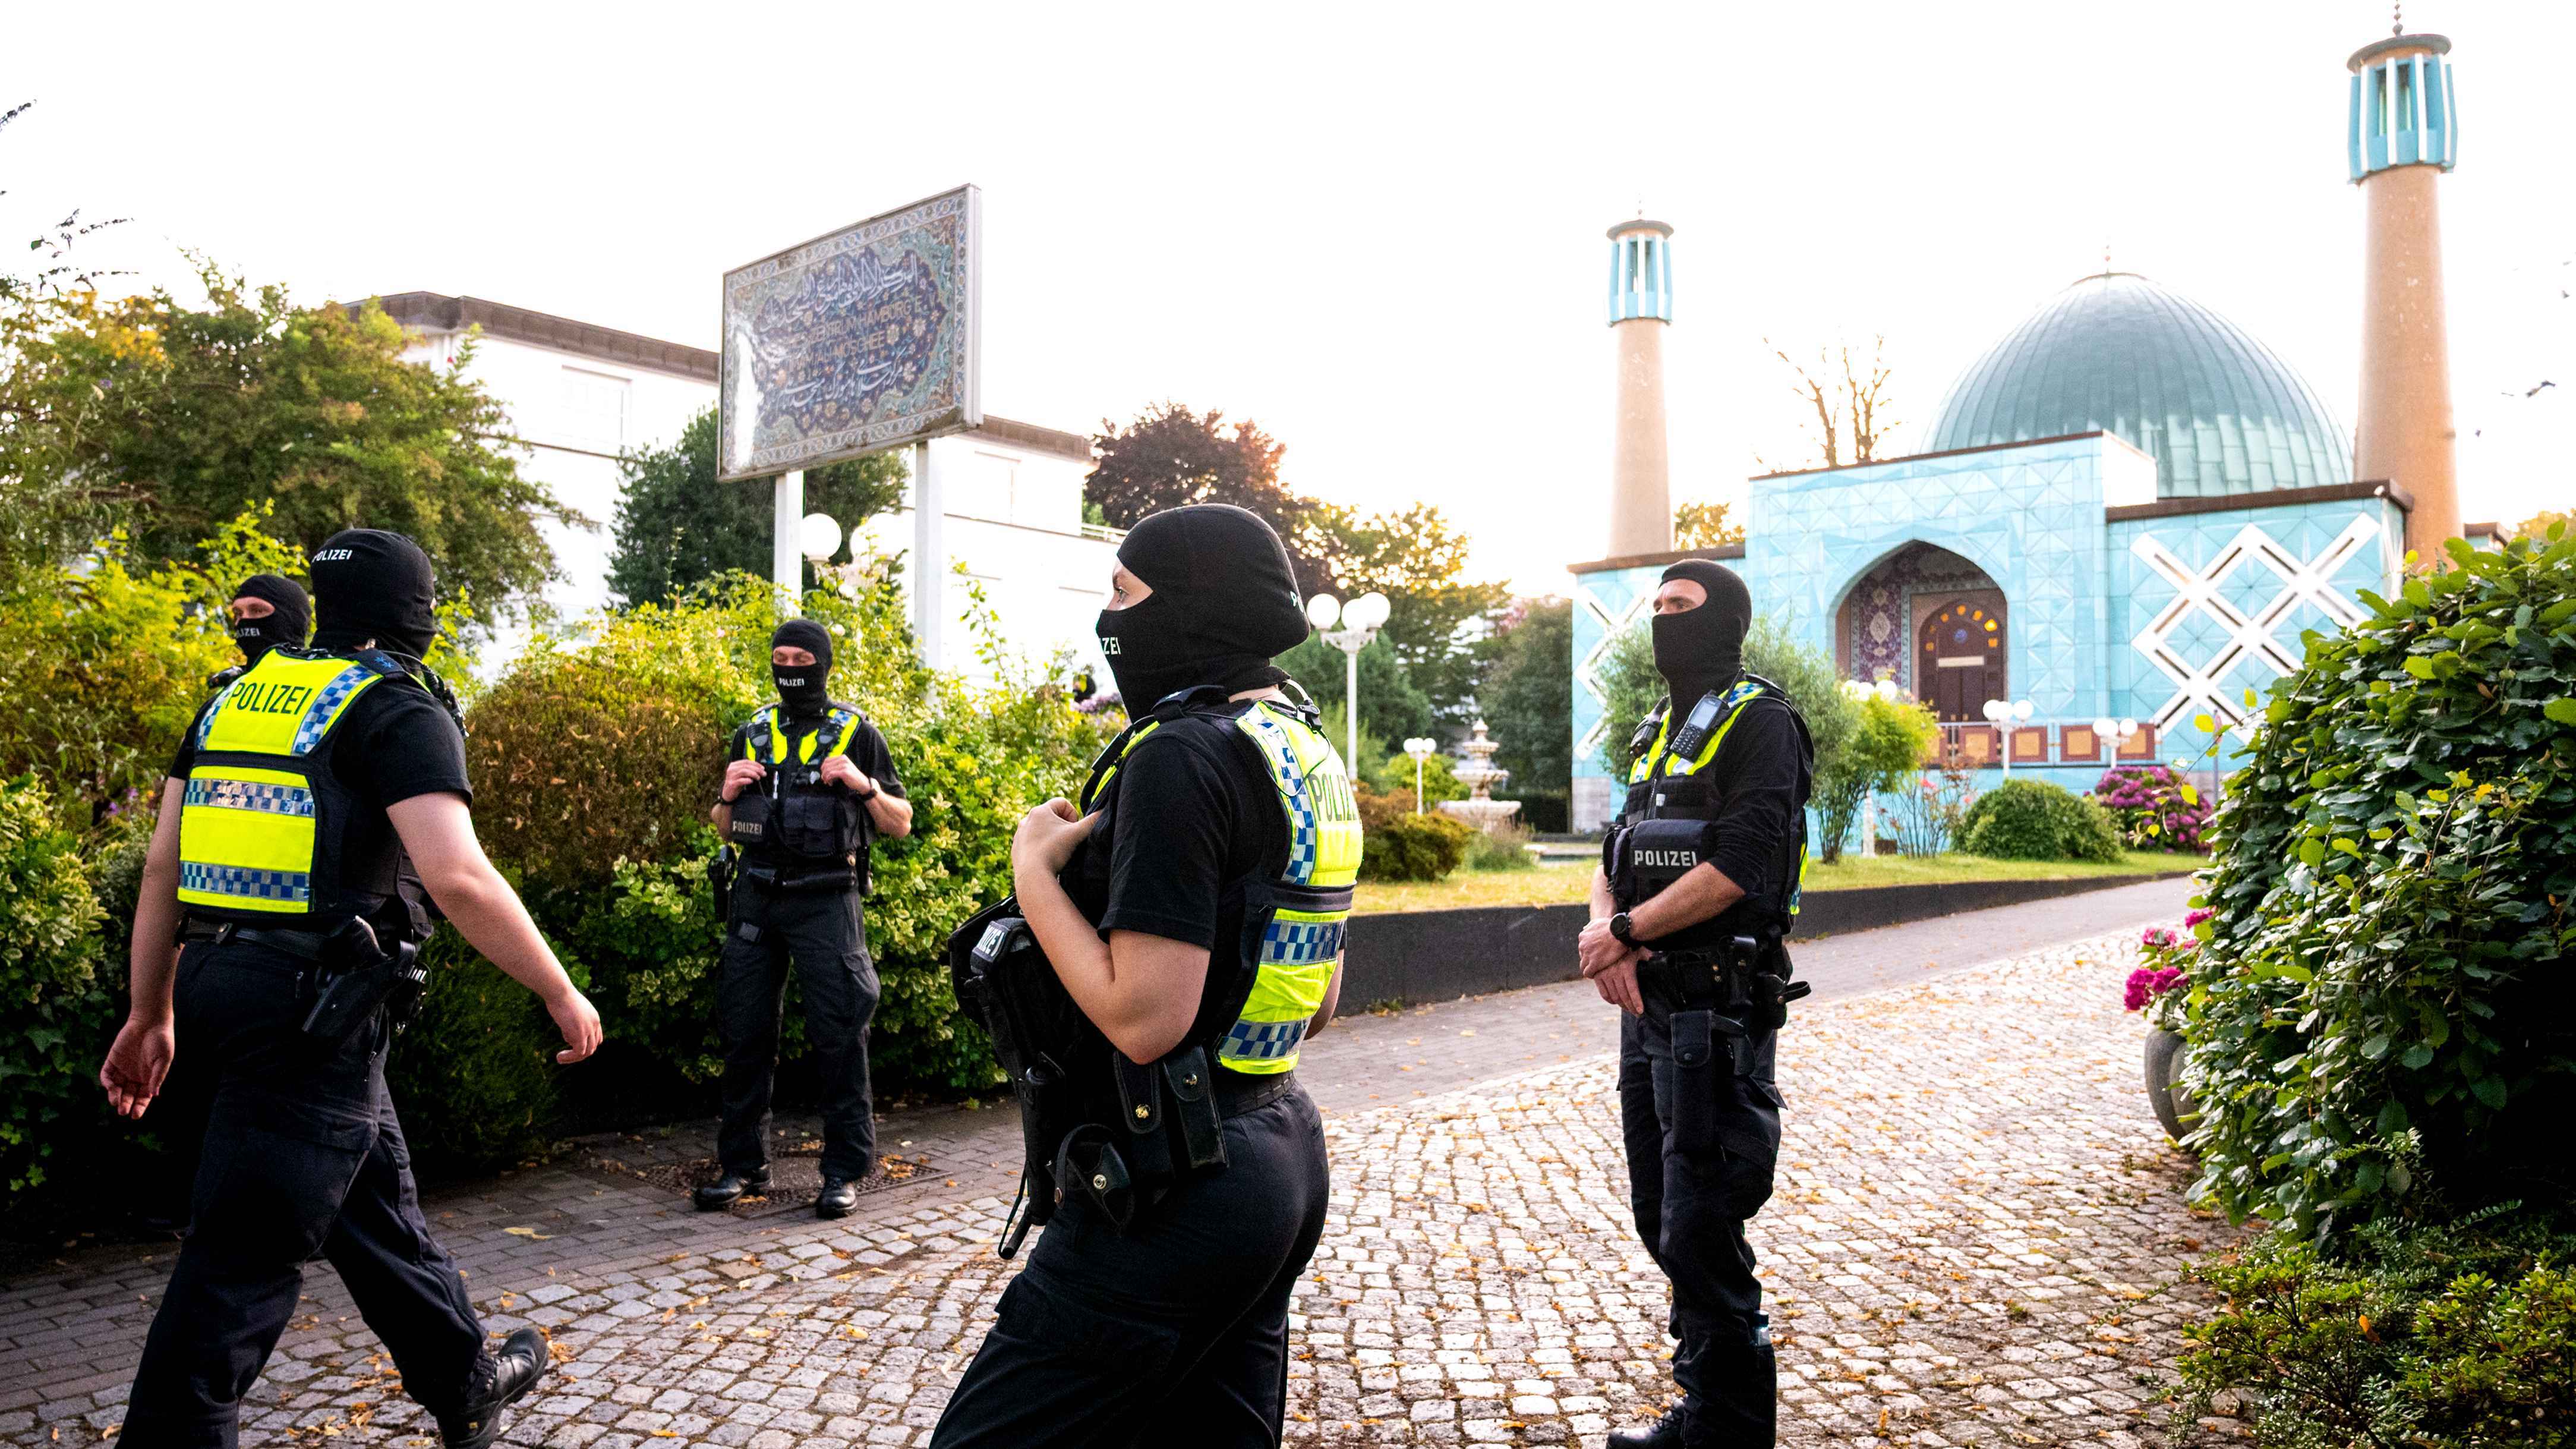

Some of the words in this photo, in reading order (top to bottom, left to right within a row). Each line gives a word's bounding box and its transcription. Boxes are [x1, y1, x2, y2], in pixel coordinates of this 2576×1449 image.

[779, 677, 805, 687] POLIZEI
[225, 682, 313, 715] POLIZEI
[733, 821, 763, 836] POLIZEI
[1634, 850, 1697, 867] POLIZEI
